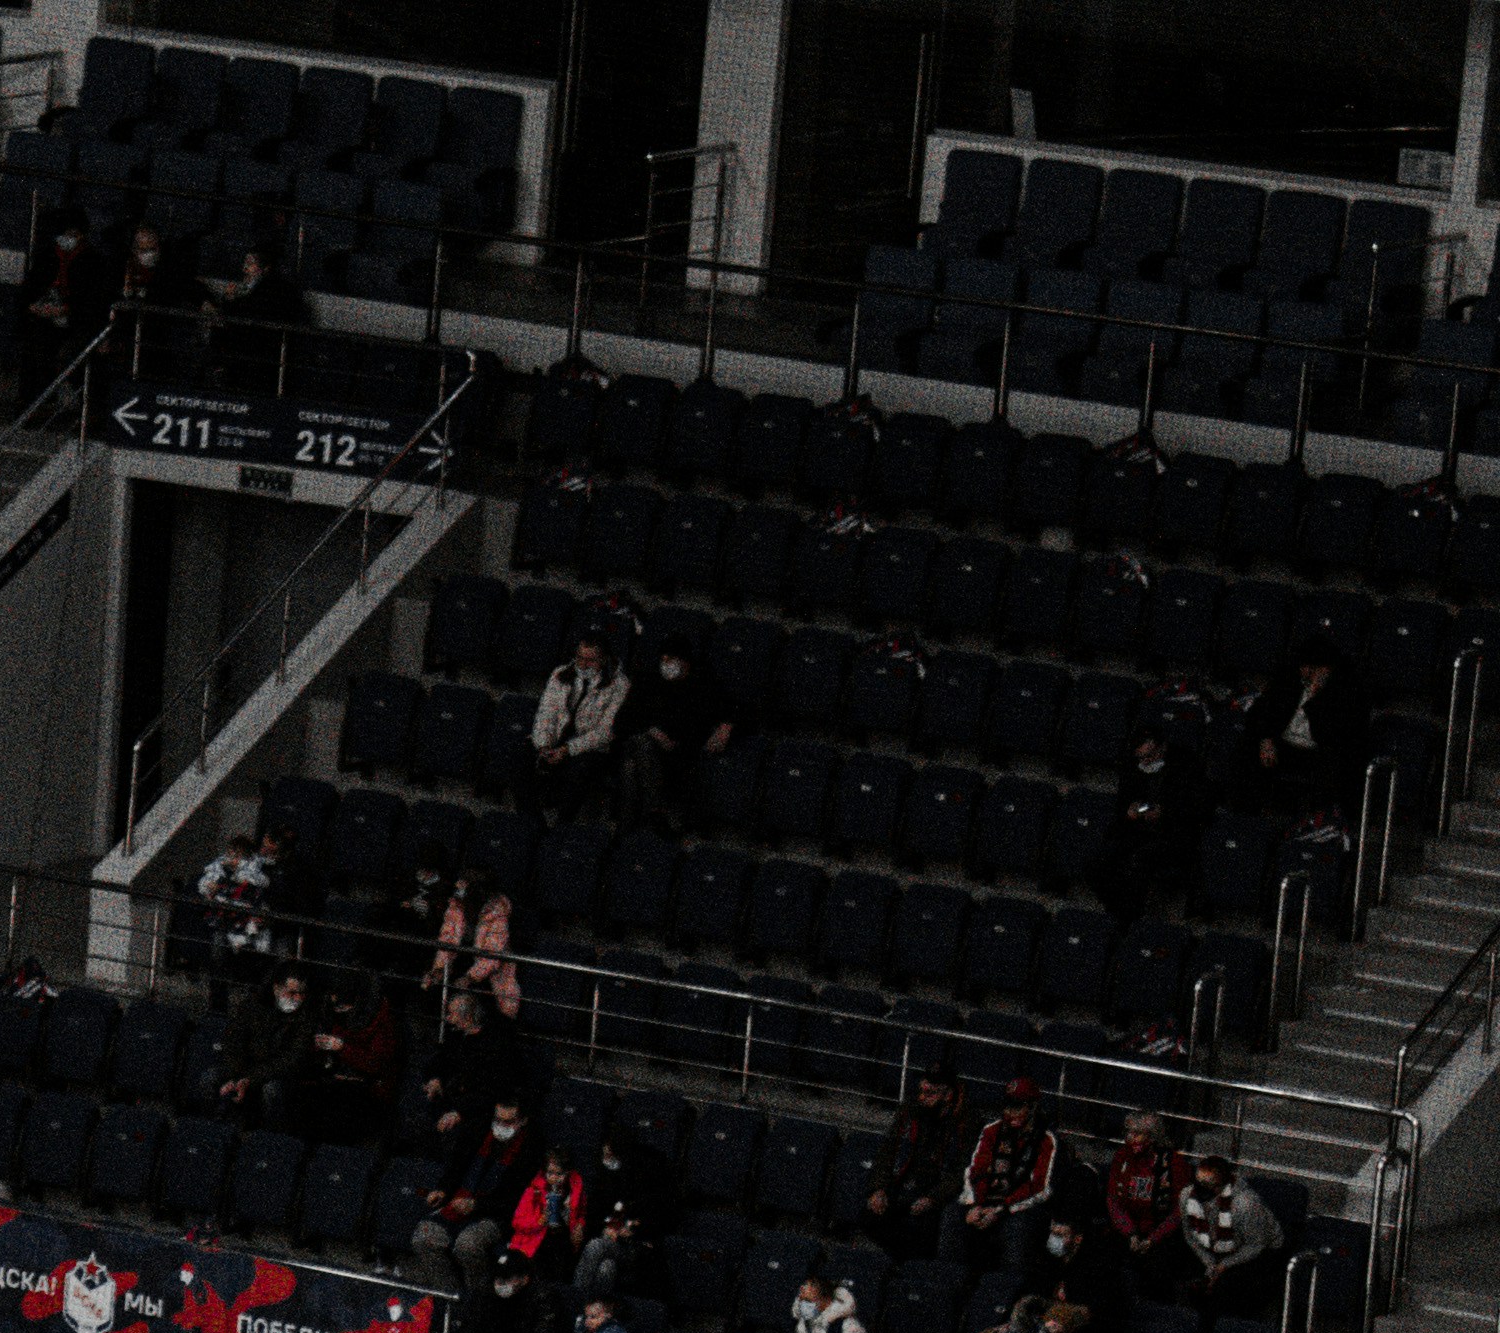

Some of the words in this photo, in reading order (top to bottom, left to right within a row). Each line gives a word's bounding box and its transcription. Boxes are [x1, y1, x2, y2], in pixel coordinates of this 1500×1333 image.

[152, 413, 211, 449] 211
[295, 430, 357, 467] 212
[124, 1291, 164, 1318] МЫ
